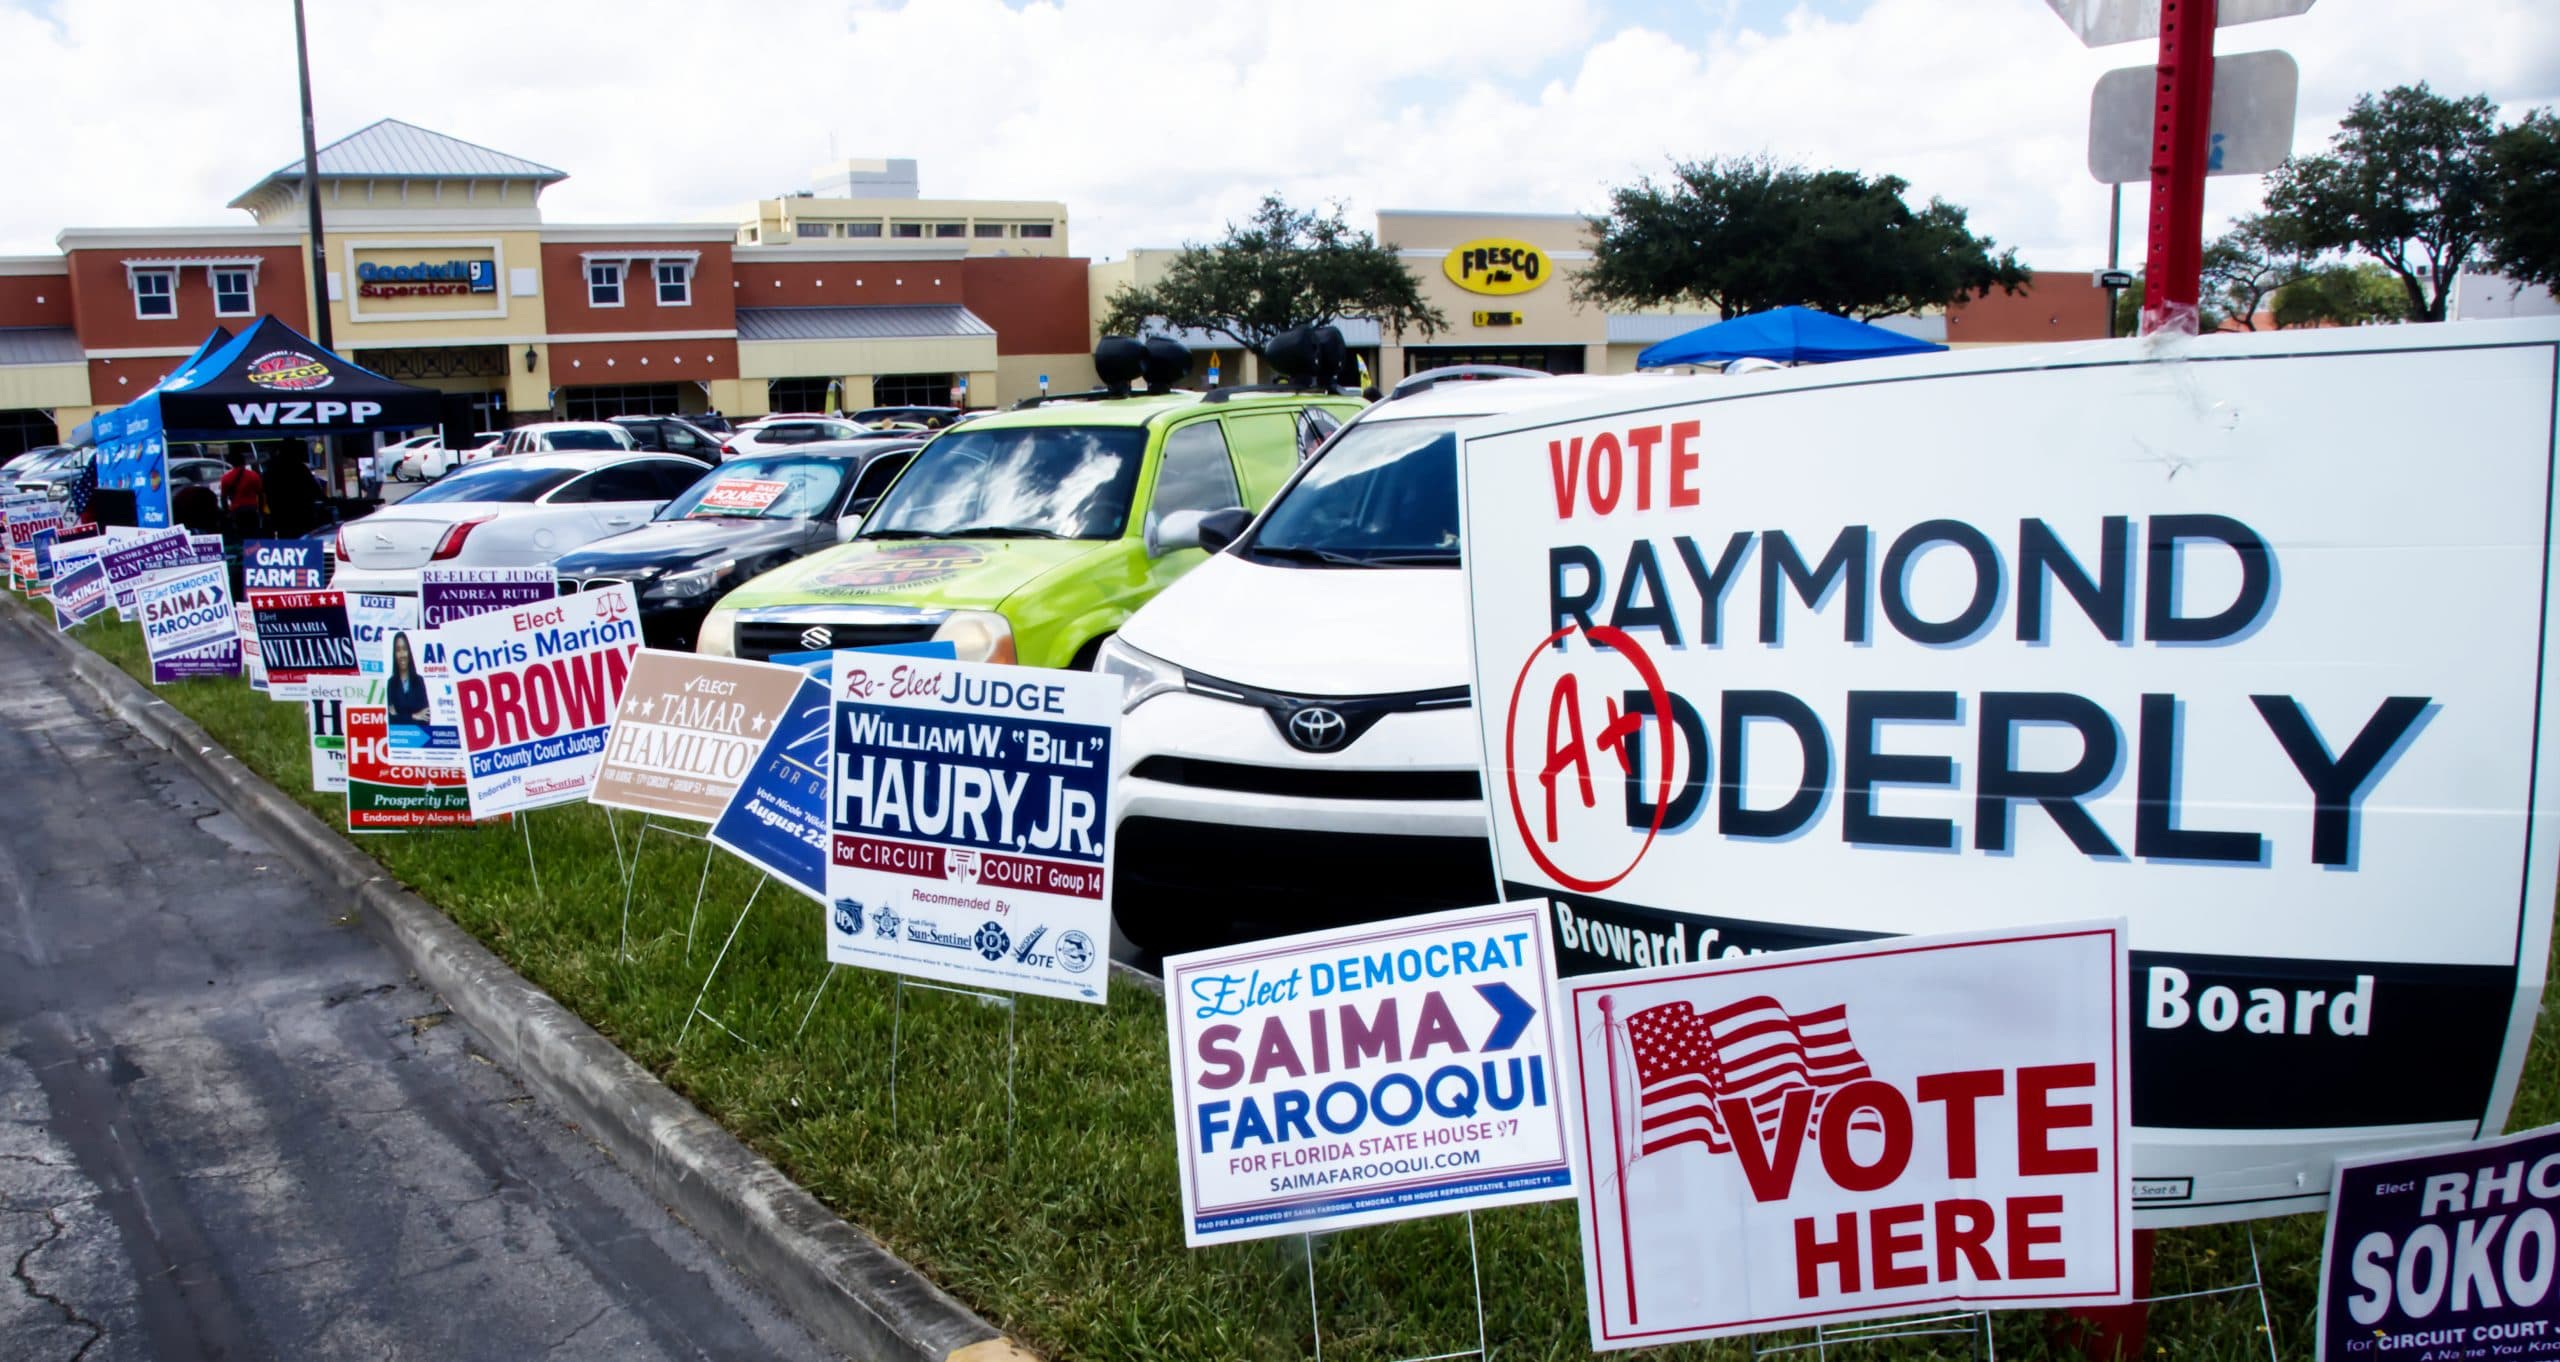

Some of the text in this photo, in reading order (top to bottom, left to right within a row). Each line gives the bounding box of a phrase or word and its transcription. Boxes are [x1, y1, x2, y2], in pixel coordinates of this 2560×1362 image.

[358, 260, 468, 281] Goodwill
[1462, 247, 1539, 280] FRESCO
[360, 284, 468, 298] Superstore
[227, 401, 382, 426] WZPP
[1547, 420, 1702, 521] VOTE
[256, 547, 308, 566] GARY
[169, 571, 220, 595] DEMOCRAT
[245, 568, 320, 588] FARMER
[423, 569, 555, 583] RE-ELECT JUDGE
[1549, 513, 2282, 652] RAYMOND
[146, 590, 210, 621] SAIMA
[280, 594, 313, 608] VOTE
[362, 597, 394, 608] VOTE
[439, 589, 540, 600] ANDREA RUTH
[149, 603, 229, 639] FAROOQUI
[258, 621, 328, 633] TANIA MARIA
[259, 612, 277, 622] Elect
[513, 605, 565, 632] Elect
[261, 637, 356, 668] WILLIAMS
[453, 619, 636, 675] Chris Marion
[311, 686, 341, 698] elect
[456, 643, 640, 753] BROWN
[698, 680, 737, 697] ELECT
[846, 664, 1065, 713] Re-Elect JUDGE
[658, 693, 746, 735] TAMAR
[848, 711, 964, 755] WILLIAM
[967, 723, 1006, 759] W.
[472, 755, 491, 774] For
[493, 748, 532, 768] County
[534, 741, 566, 761] Court
[567, 734, 601, 754] Judge
[478, 778, 512, 801] Endorsed
[512, 775, 522, 787] By
[769, 759, 802, 786] FOR
[374, 794, 467, 809] Prosperity For
[756, 786, 775, 805] Vote
[776, 797, 803, 818] Nicole
[835, 752, 1105, 857] HAURY, JR.
[362, 813, 410, 823] Endorsed
[411, 812, 424, 826] by
[427, 813, 455, 823] Alcee
[744, 798, 804, 838] August
[837, 840, 855, 861] For
[859, 844, 935, 872] CIRCUIT
[983, 860, 1043, 886] COURT
[1048, 868, 1086, 893] Group
[1087, 872, 1101, 893] 14
[912, 888, 1011, 917] Recommended By
[1191, 932, 1529, 1020] Elect DEMOCRAT
[1555, 901, 2375, 1037] Broward Board
[1197, 990, 1471, 1090] SAIMA
[1197, 1054, 1548, 1154] FAROOQUI
[1229, 1119, 1519, 1175] FOR FLORIDA STATE HOUSE 97
[1716, 1062, 2098, 1203] VOTE
[1270, 1149, 1480, 1192] SAIMAFAROOQUI.COM
[1197, 1221, 1214, 1229] PAID
[1215, 1219, 1230, 1228] FOR
[1230, 1217, 1245, 1225] AND
[1245, 1211, 1283, 1223] APPROVED
[1283, 1210, 1294, 1218] BY
[1294, 1208, 1317, 1217] SAIMA
[1398, 1193, 1413, 1203] FOR
[1414, 1190, 1440, 1201] HOUSE
[1507, 1177, 1541, 1189] DISTRICT
[2141, 1185, 2168, 1195] Seat
[2375, 1180, 2416, 1196] Elect
[1794, 1194, 2066, 1299] HERE
[2347, 1207, 2556, 1325] SOKO
[2346, 1338, 2373, 1352] for
[2377, 1327, 2467, 1351] CIRCUIT
[2472, 1320, 2549, 1341] COURT
[2421, 1352, 2434, 1362] A
[2492, 1343, 2523, 1356] You
